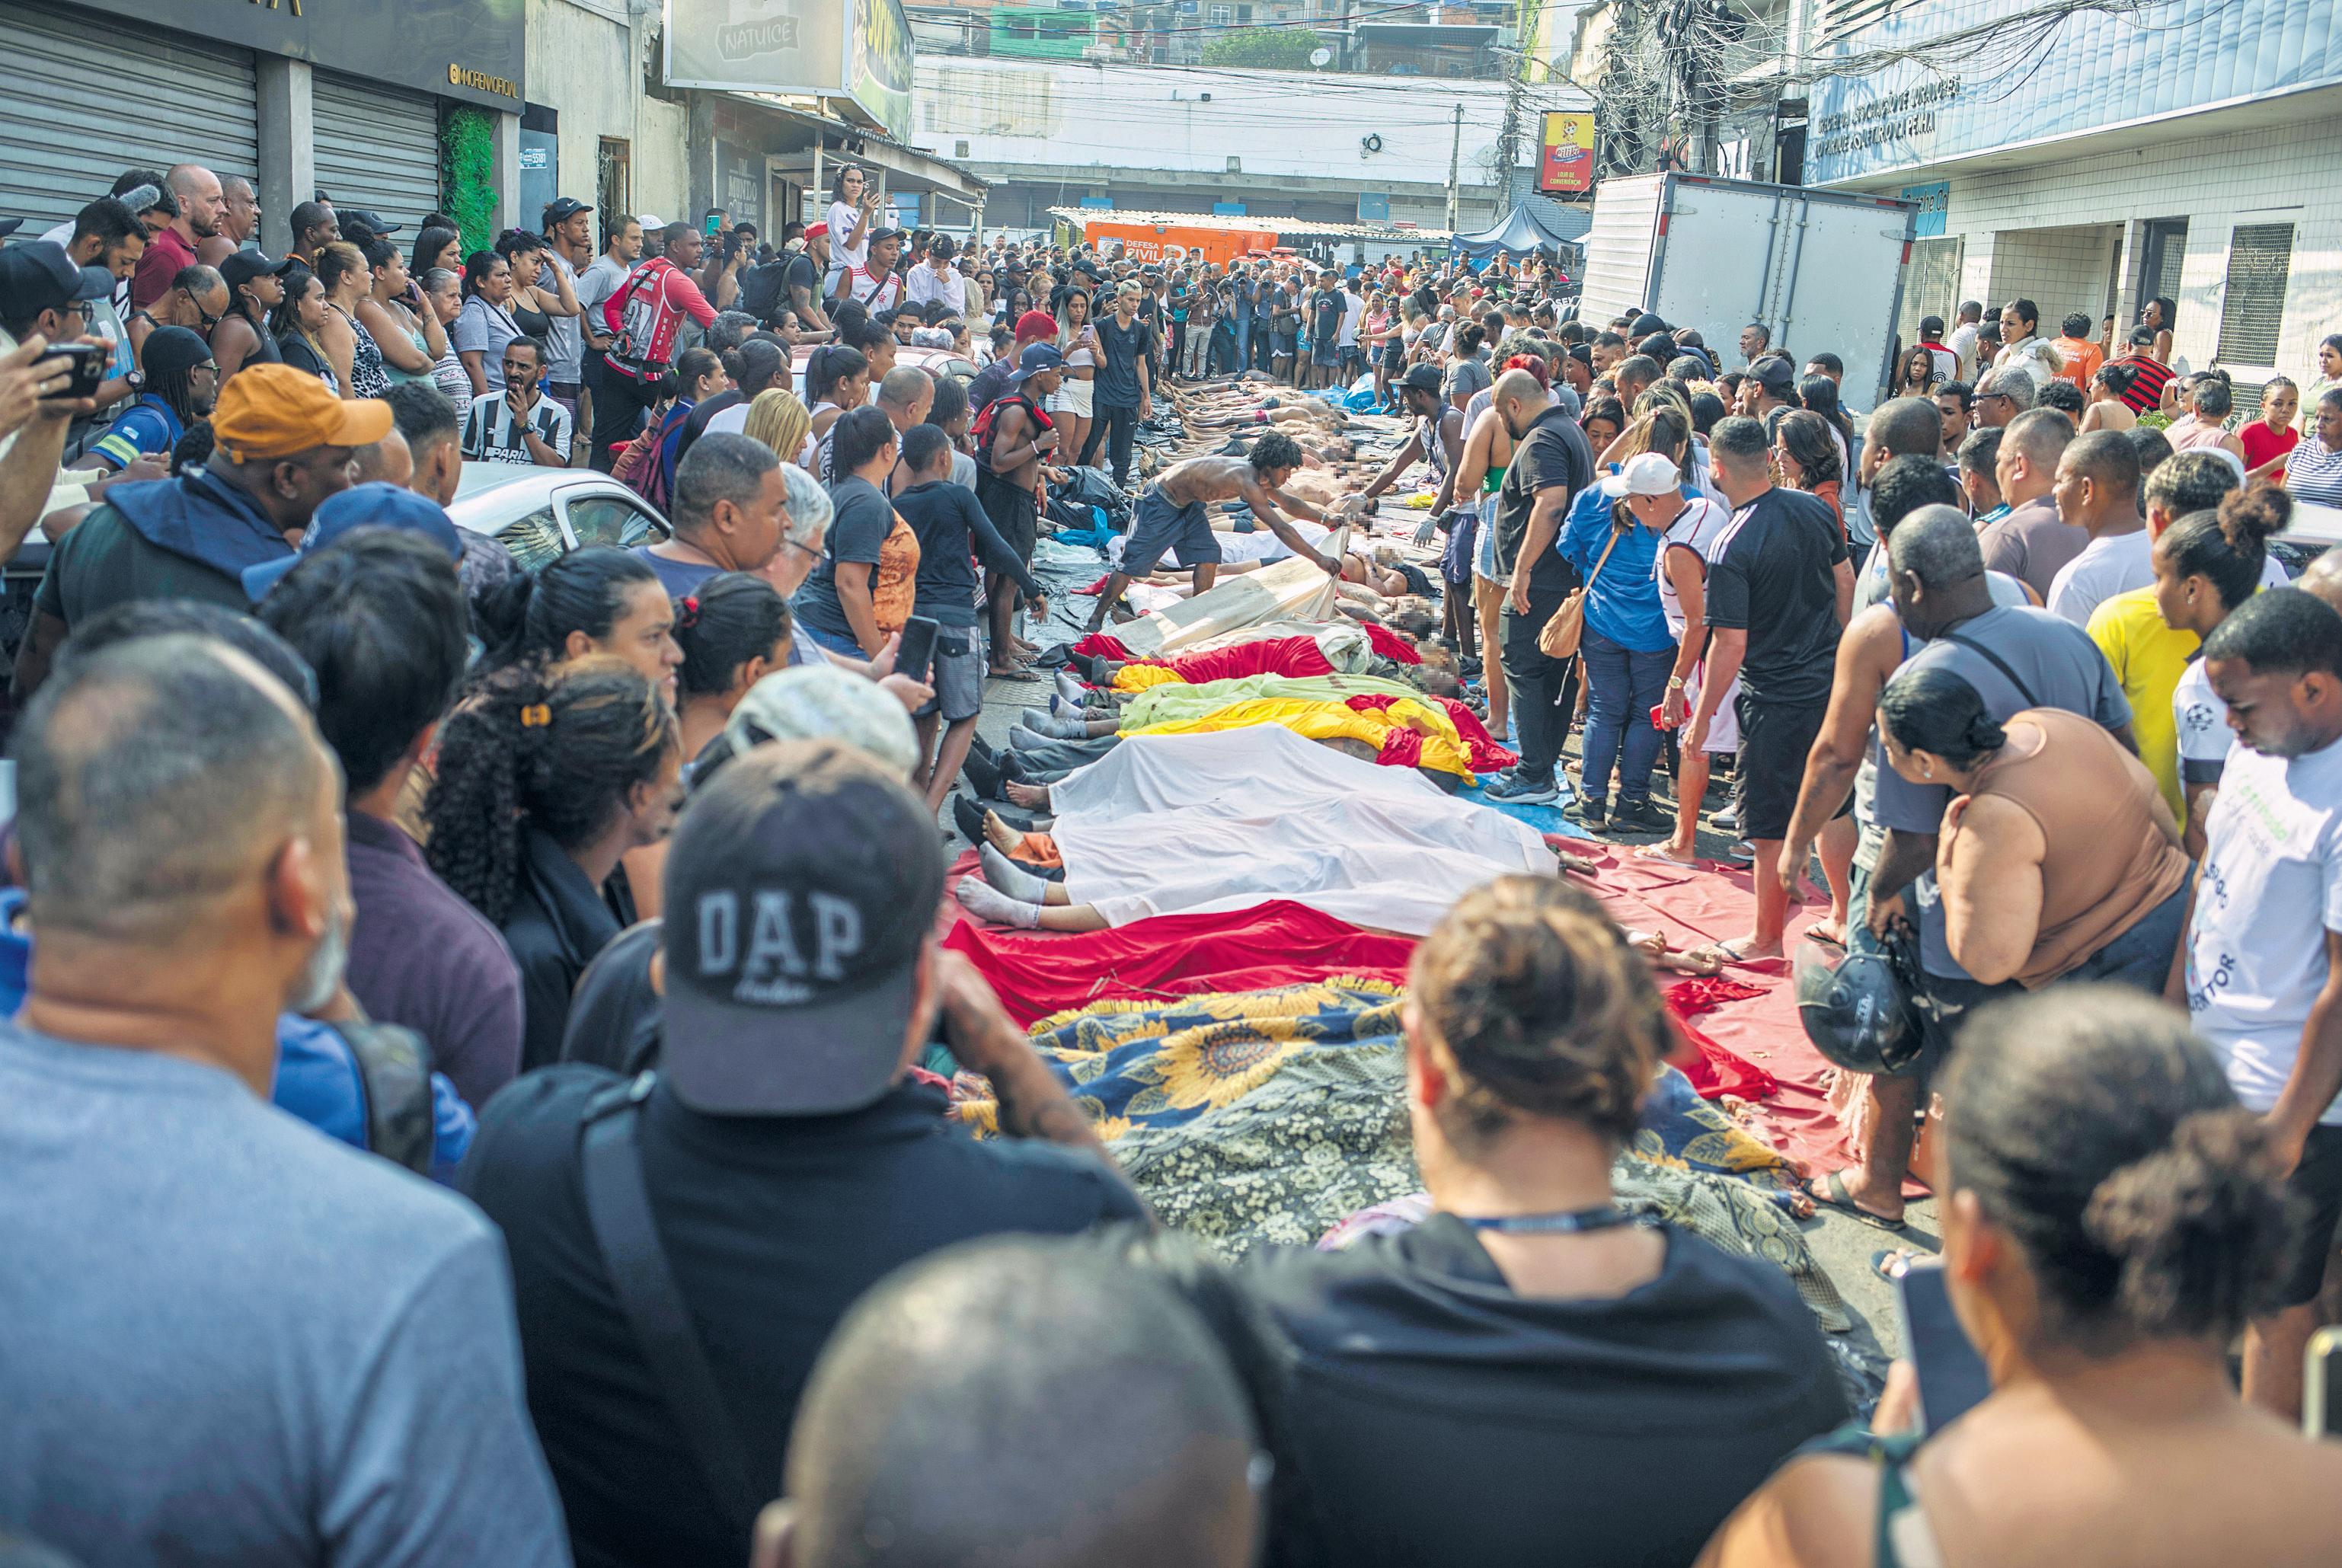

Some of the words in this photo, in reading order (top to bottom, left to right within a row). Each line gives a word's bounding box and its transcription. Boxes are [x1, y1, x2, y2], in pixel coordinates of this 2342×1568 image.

[725, 22, 792, 53] NATUICE
[728, 175, 757, 202] MUNDO
[1126, 239, 1159, 251] DEFESA
[485, 447, 525, 459] PARI
